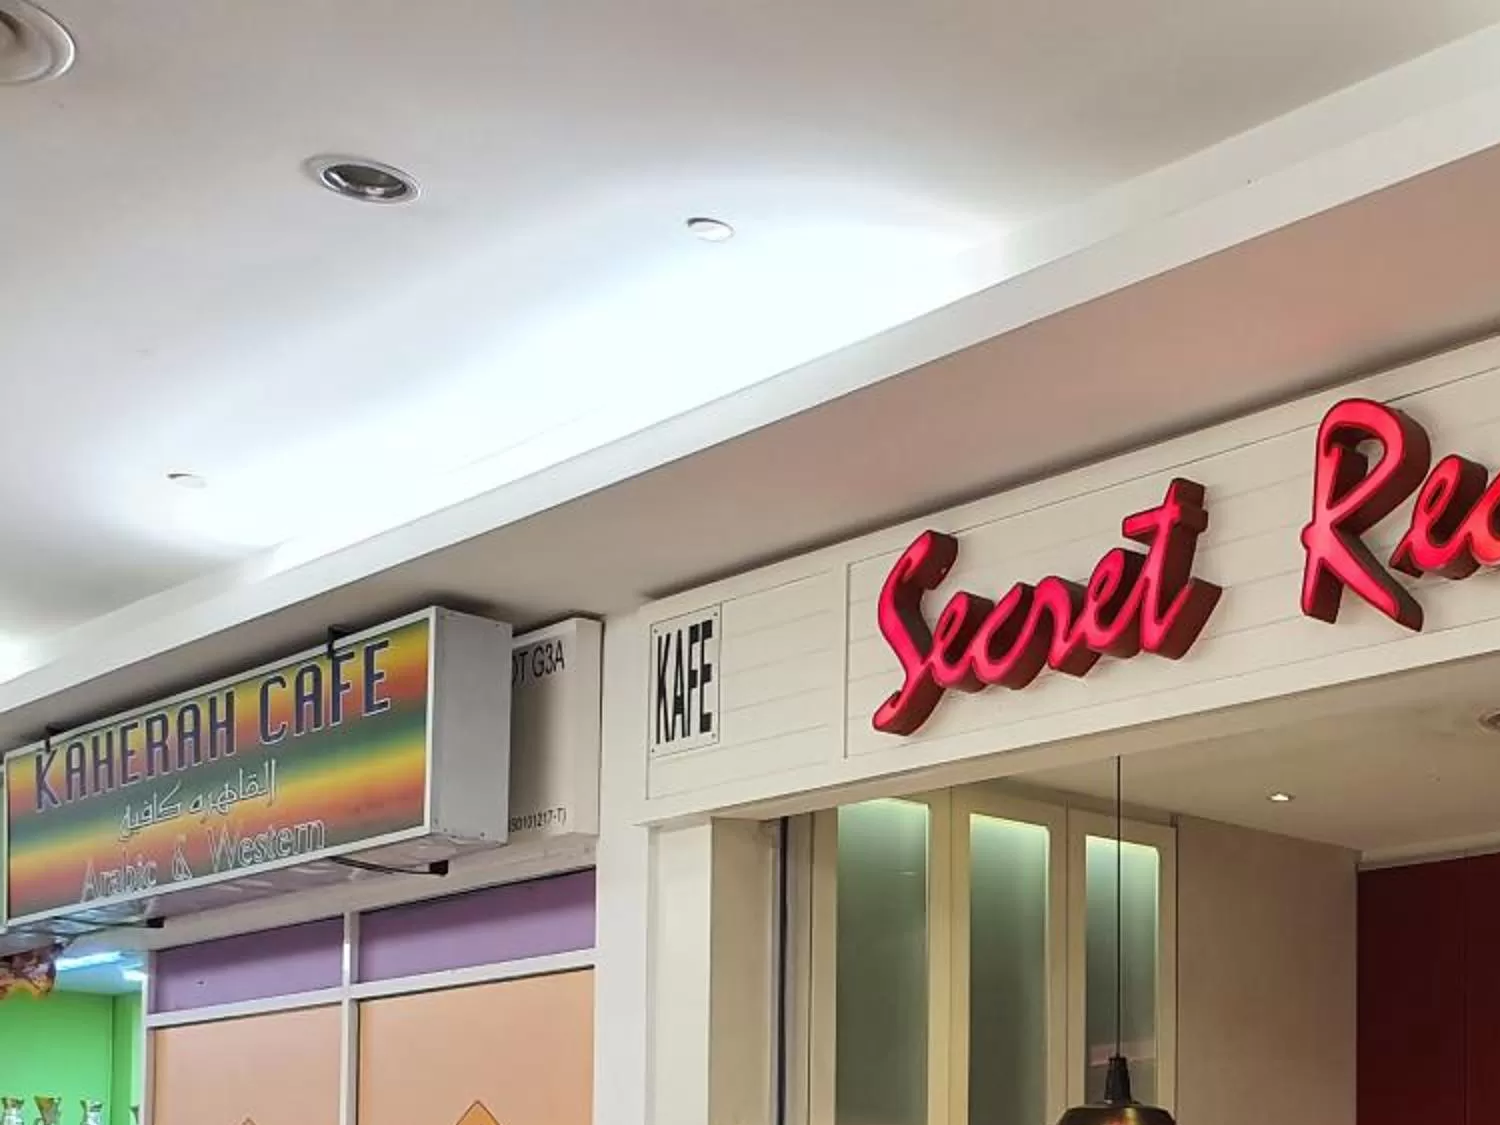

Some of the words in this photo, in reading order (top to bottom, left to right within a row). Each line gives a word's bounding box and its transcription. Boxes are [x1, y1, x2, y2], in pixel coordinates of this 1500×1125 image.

[532, 640, 565, 678] G3A
[873, 478, 1222, 736] Secret
[35, 688, 237, 812] KAHERAH
[258, 638, 391, 746] CAFE
[656, 619, 713, 744] KAFE
[82, 845, 158, 904] Arabic
[207, 819, 325, 873] Western
